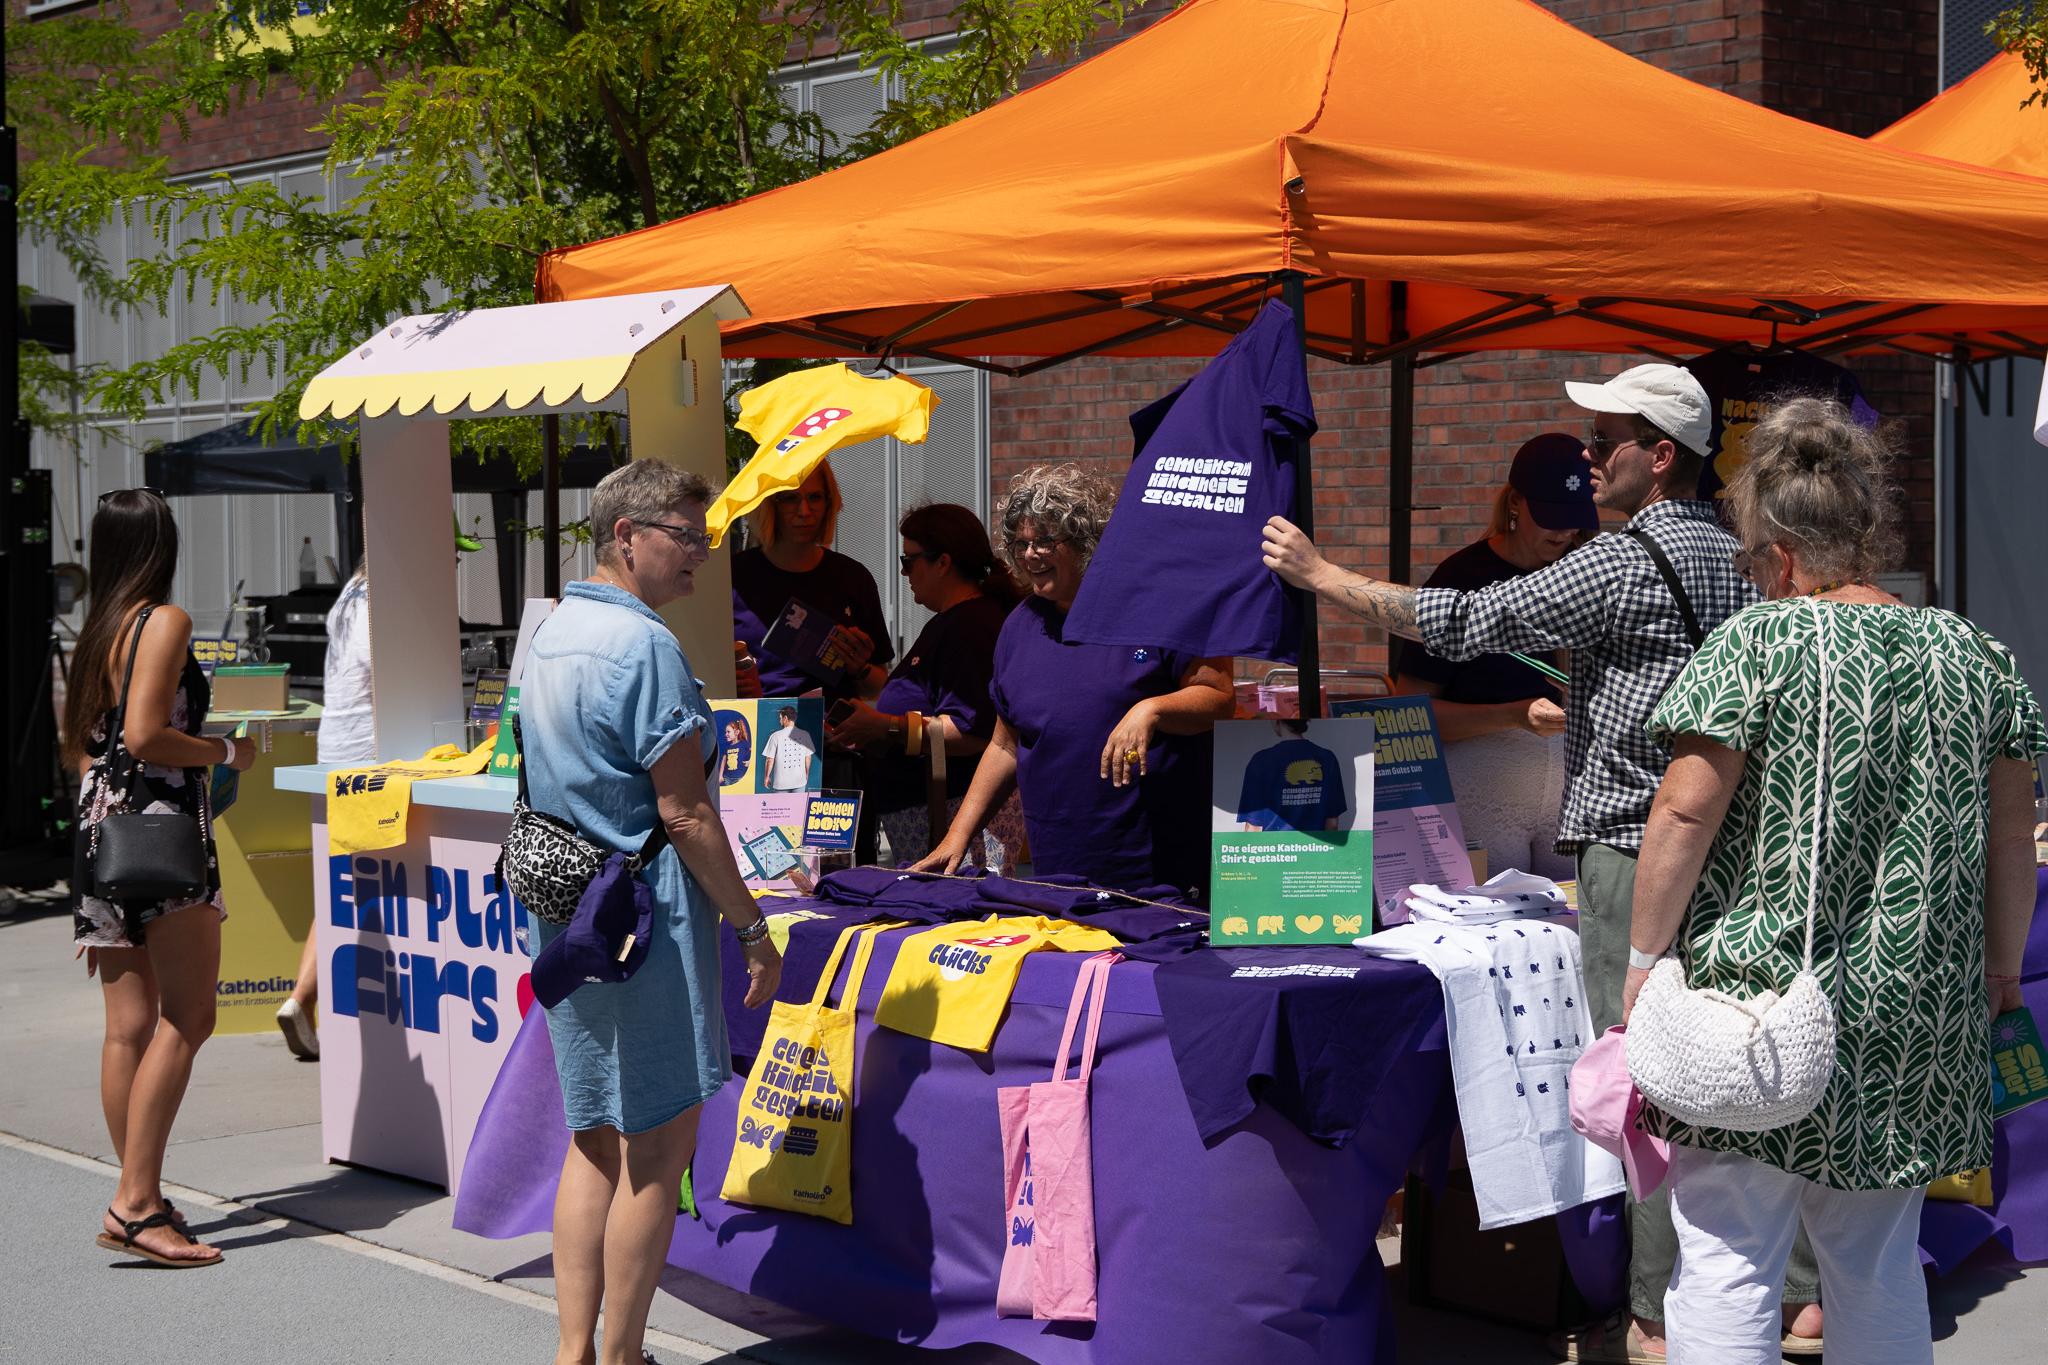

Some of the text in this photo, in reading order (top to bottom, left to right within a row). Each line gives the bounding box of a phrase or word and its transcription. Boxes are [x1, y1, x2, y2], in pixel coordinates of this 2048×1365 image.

[1147, 473, 1248, 494] Kindheit
[1141, 489, 1245, 514] gestalten
[1221, 843, 1335, 854] Das eigene Katholino-
[1221, 854, 1298, 865] Shirt gestalten
[329, 854, 409, 938] Ein
[216, 976, 297, 995] Katholin
